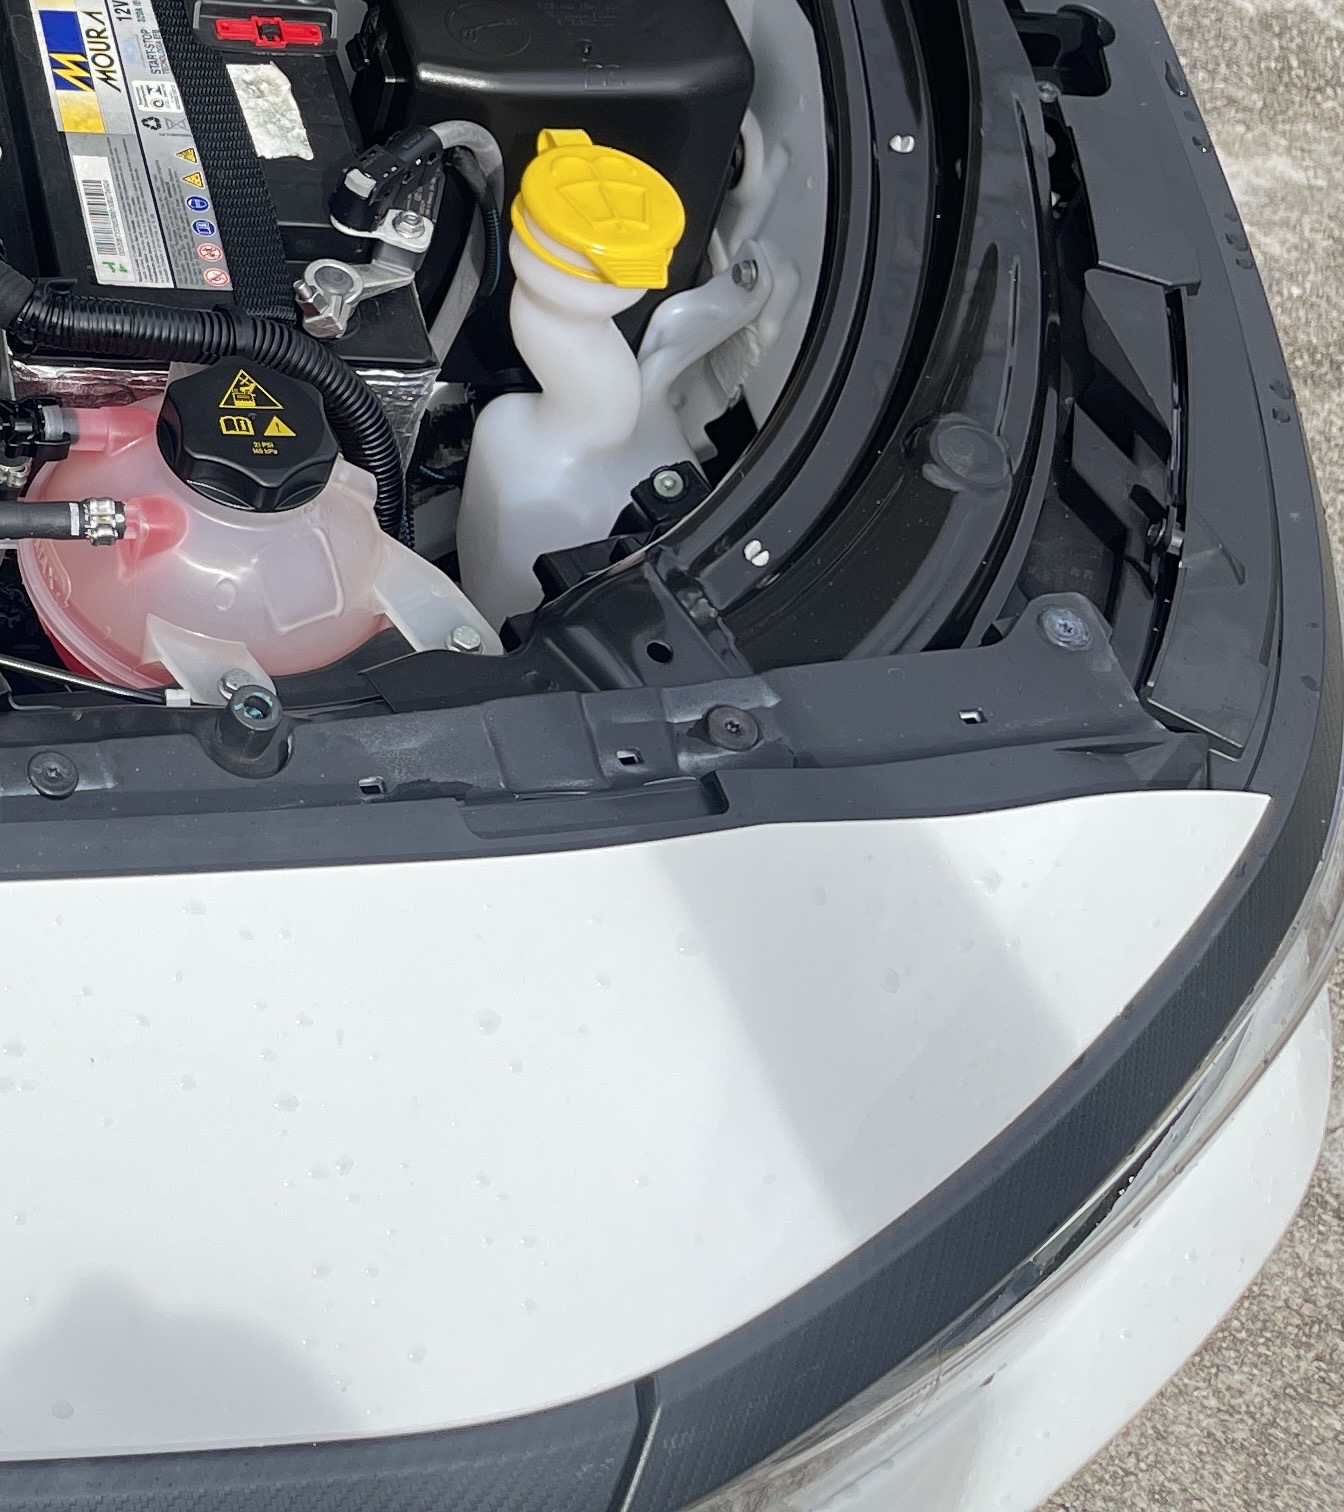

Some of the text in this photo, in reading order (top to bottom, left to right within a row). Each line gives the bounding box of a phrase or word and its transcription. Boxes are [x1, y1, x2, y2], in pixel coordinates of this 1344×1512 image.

[111, 0, 133, 22] 12V
[83, 10, 121, 93] MOURA
[140, 28, 163, 75] START-STOP
